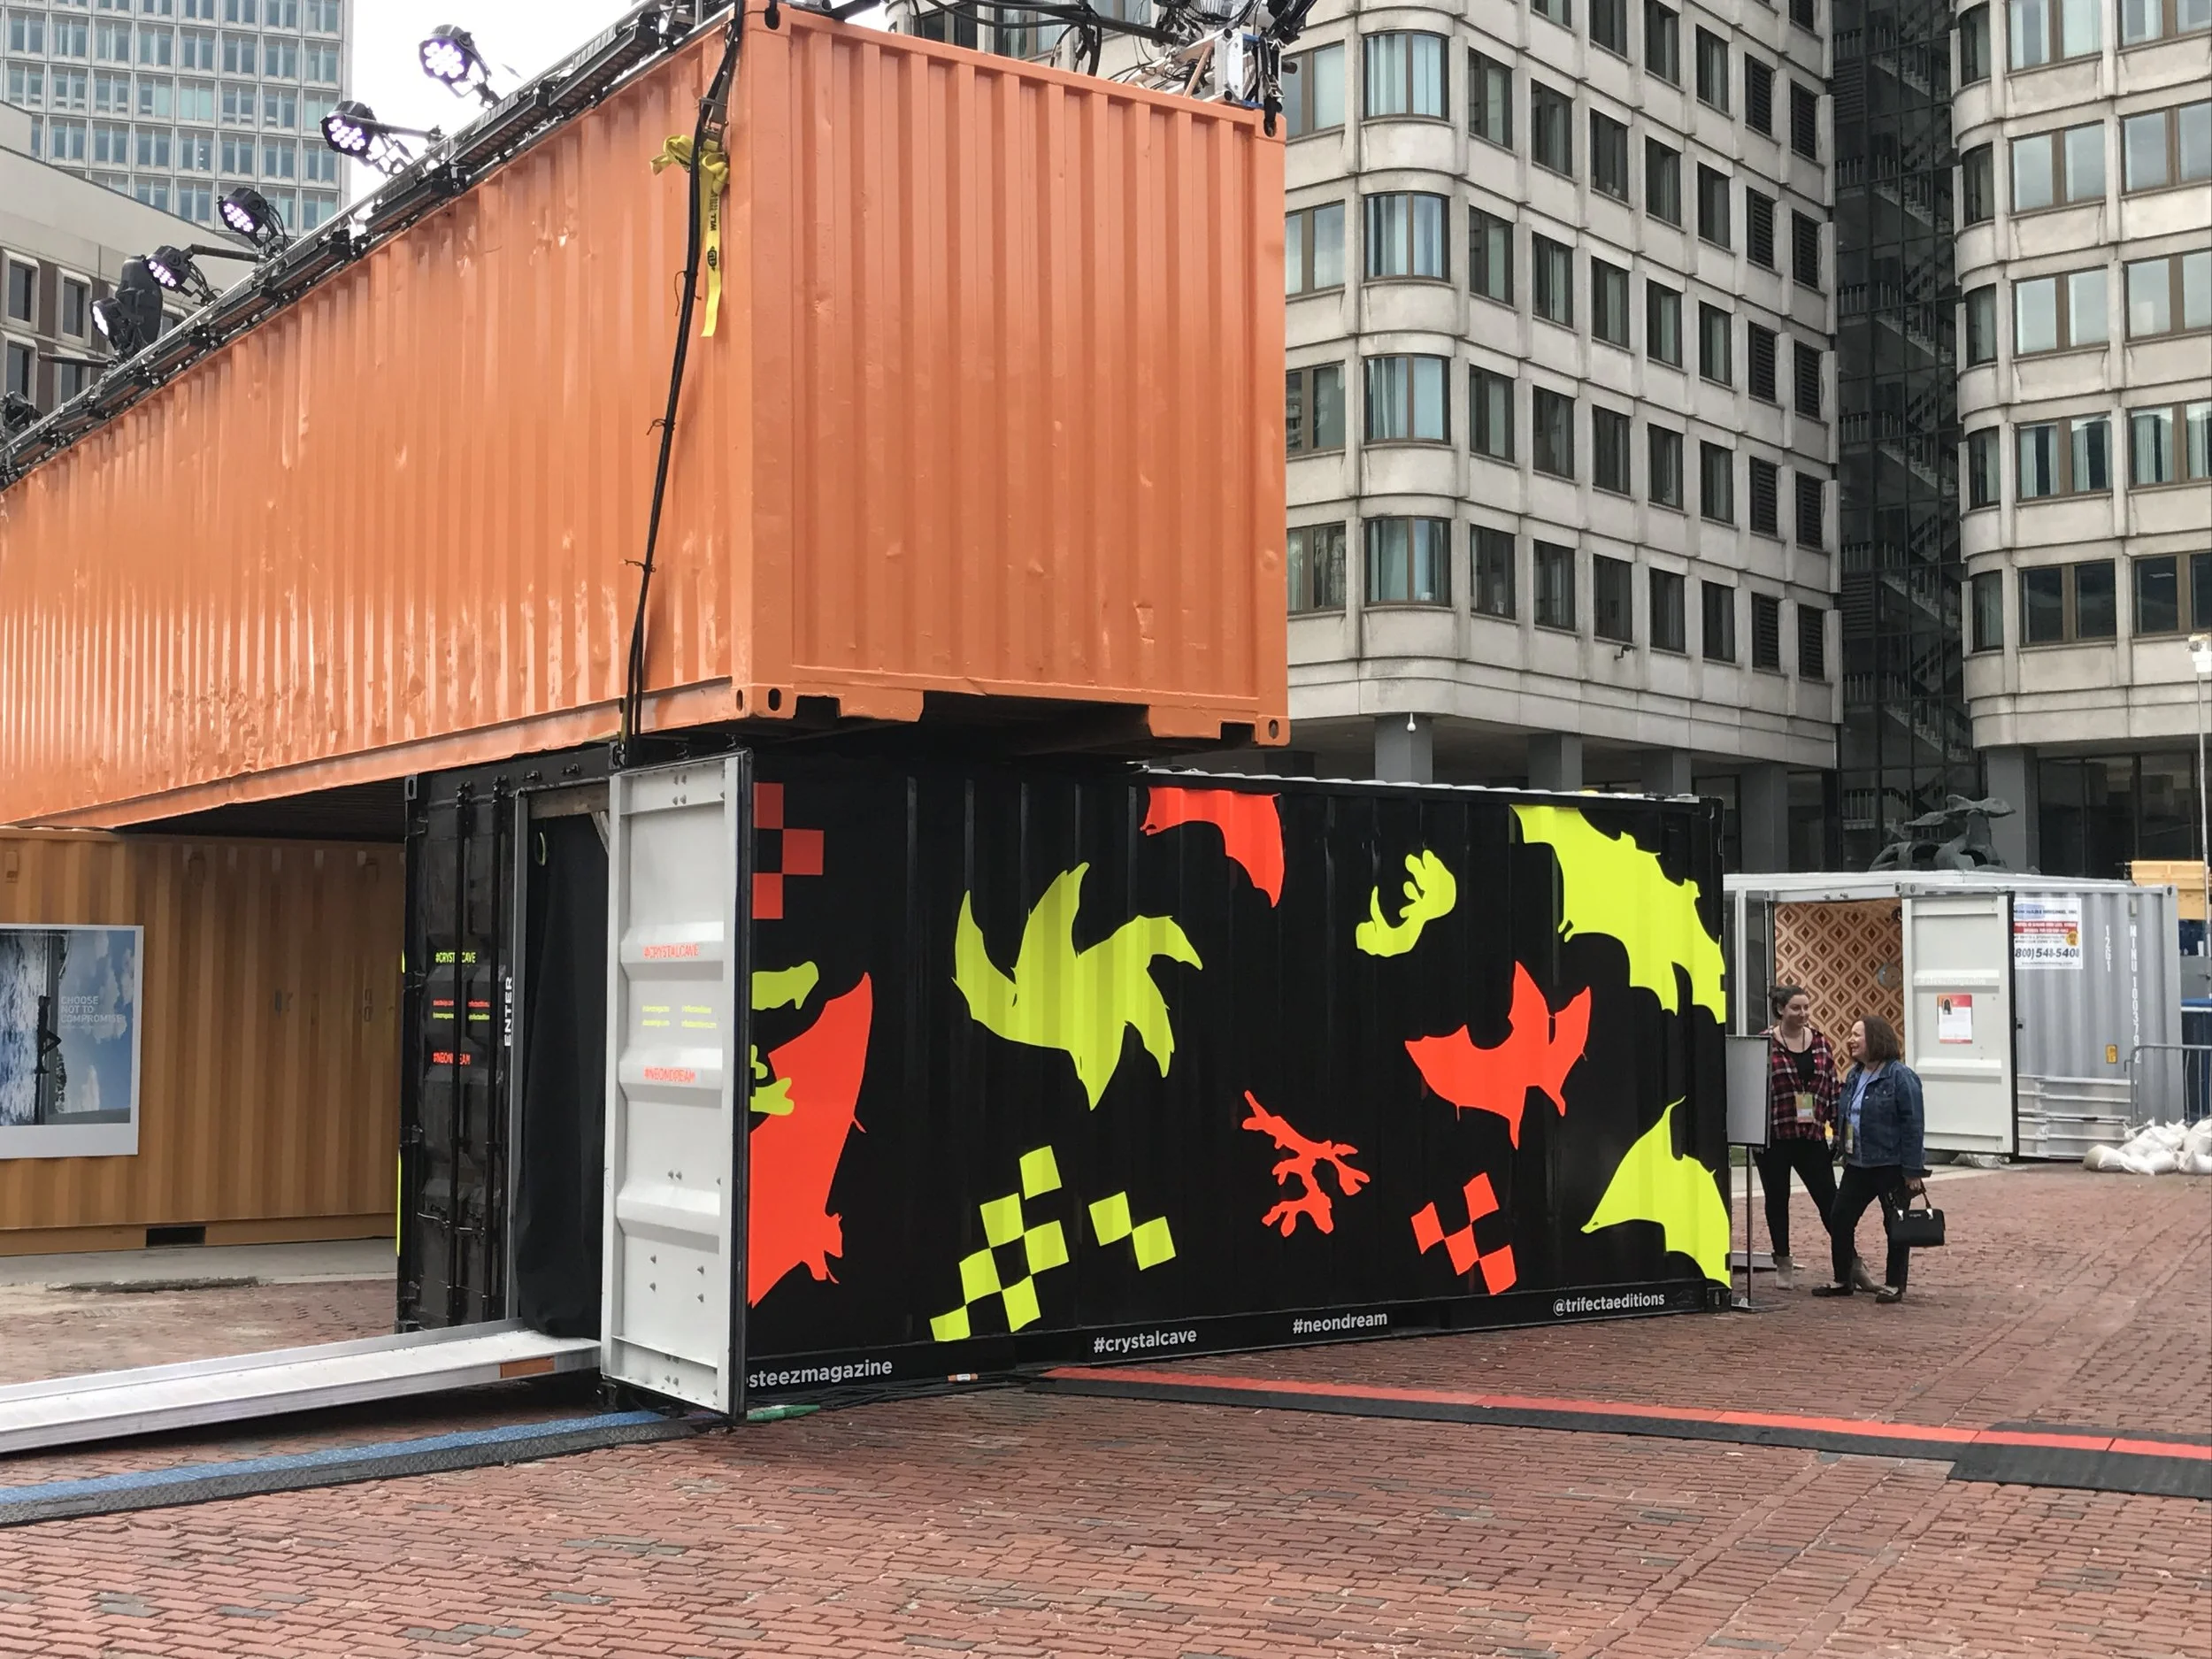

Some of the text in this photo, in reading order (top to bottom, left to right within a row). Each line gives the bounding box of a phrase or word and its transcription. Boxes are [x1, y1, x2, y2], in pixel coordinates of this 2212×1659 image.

[435, 952, 476, 964] #CRYSTCAVE
[60, 995, 99, 1005] CHOOSE
[60, 1005, 95, 1014] NOT TO
[503, 976, 513, 1047] ENTER
[60, 1014, 123, 1024] COMPROMISE
[433, 1051, 471, 1064] #NEONEAM
[644, 1066, 696, 1083] #NEONDREAM
[1552, 1291, 1665, 1317] @trifectaeditions
[1292, 1310, 1388, 1334] #neondream
[1093, 1328, 1197, 1355] #crystalcave
[747, 1359, 893, 1390] steezmagazine
